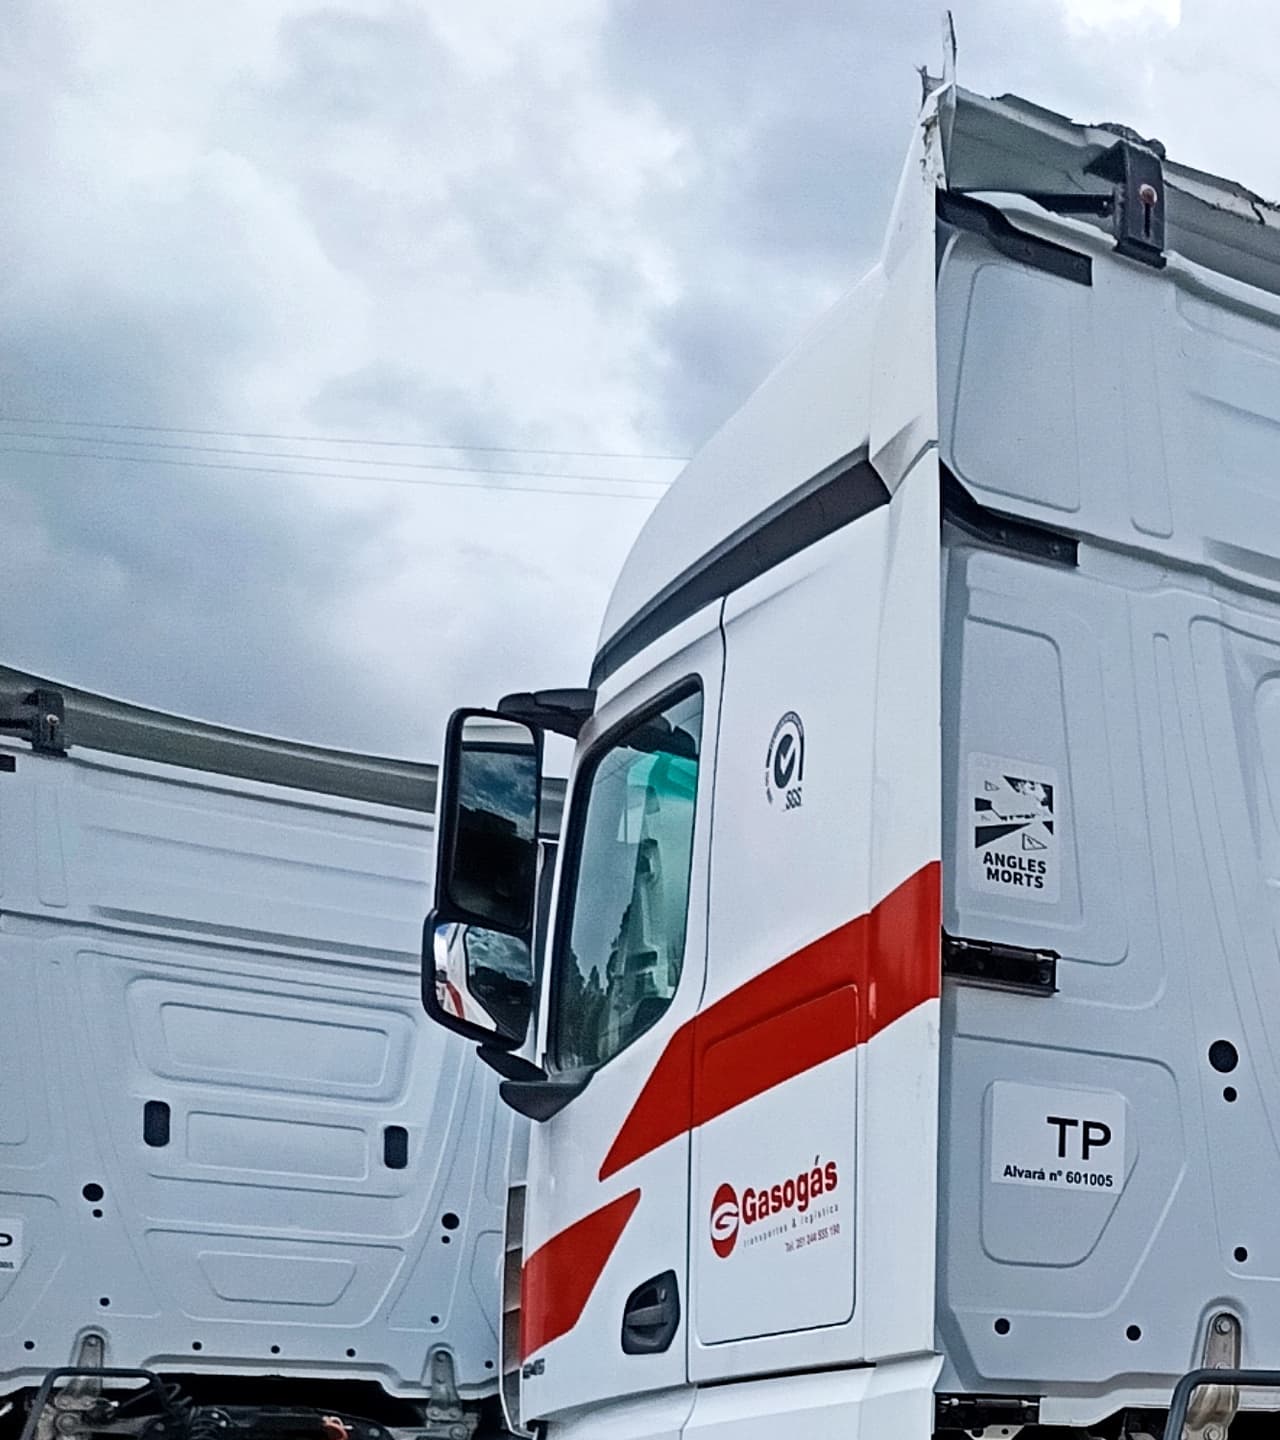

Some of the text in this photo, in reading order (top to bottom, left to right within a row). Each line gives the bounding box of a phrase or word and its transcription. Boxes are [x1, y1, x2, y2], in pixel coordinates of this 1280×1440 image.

[983, 851, 1046, 874] ANGLES
[987, 867, 1044, 889] MORTS
[1047, 1116, 1112, 1160] TP
[1003, 1164, 1045, 1181] Alvará
[1065, 1171, 1113, 1187] 601005
[742, 1155, 838, 1225] Gasogás
